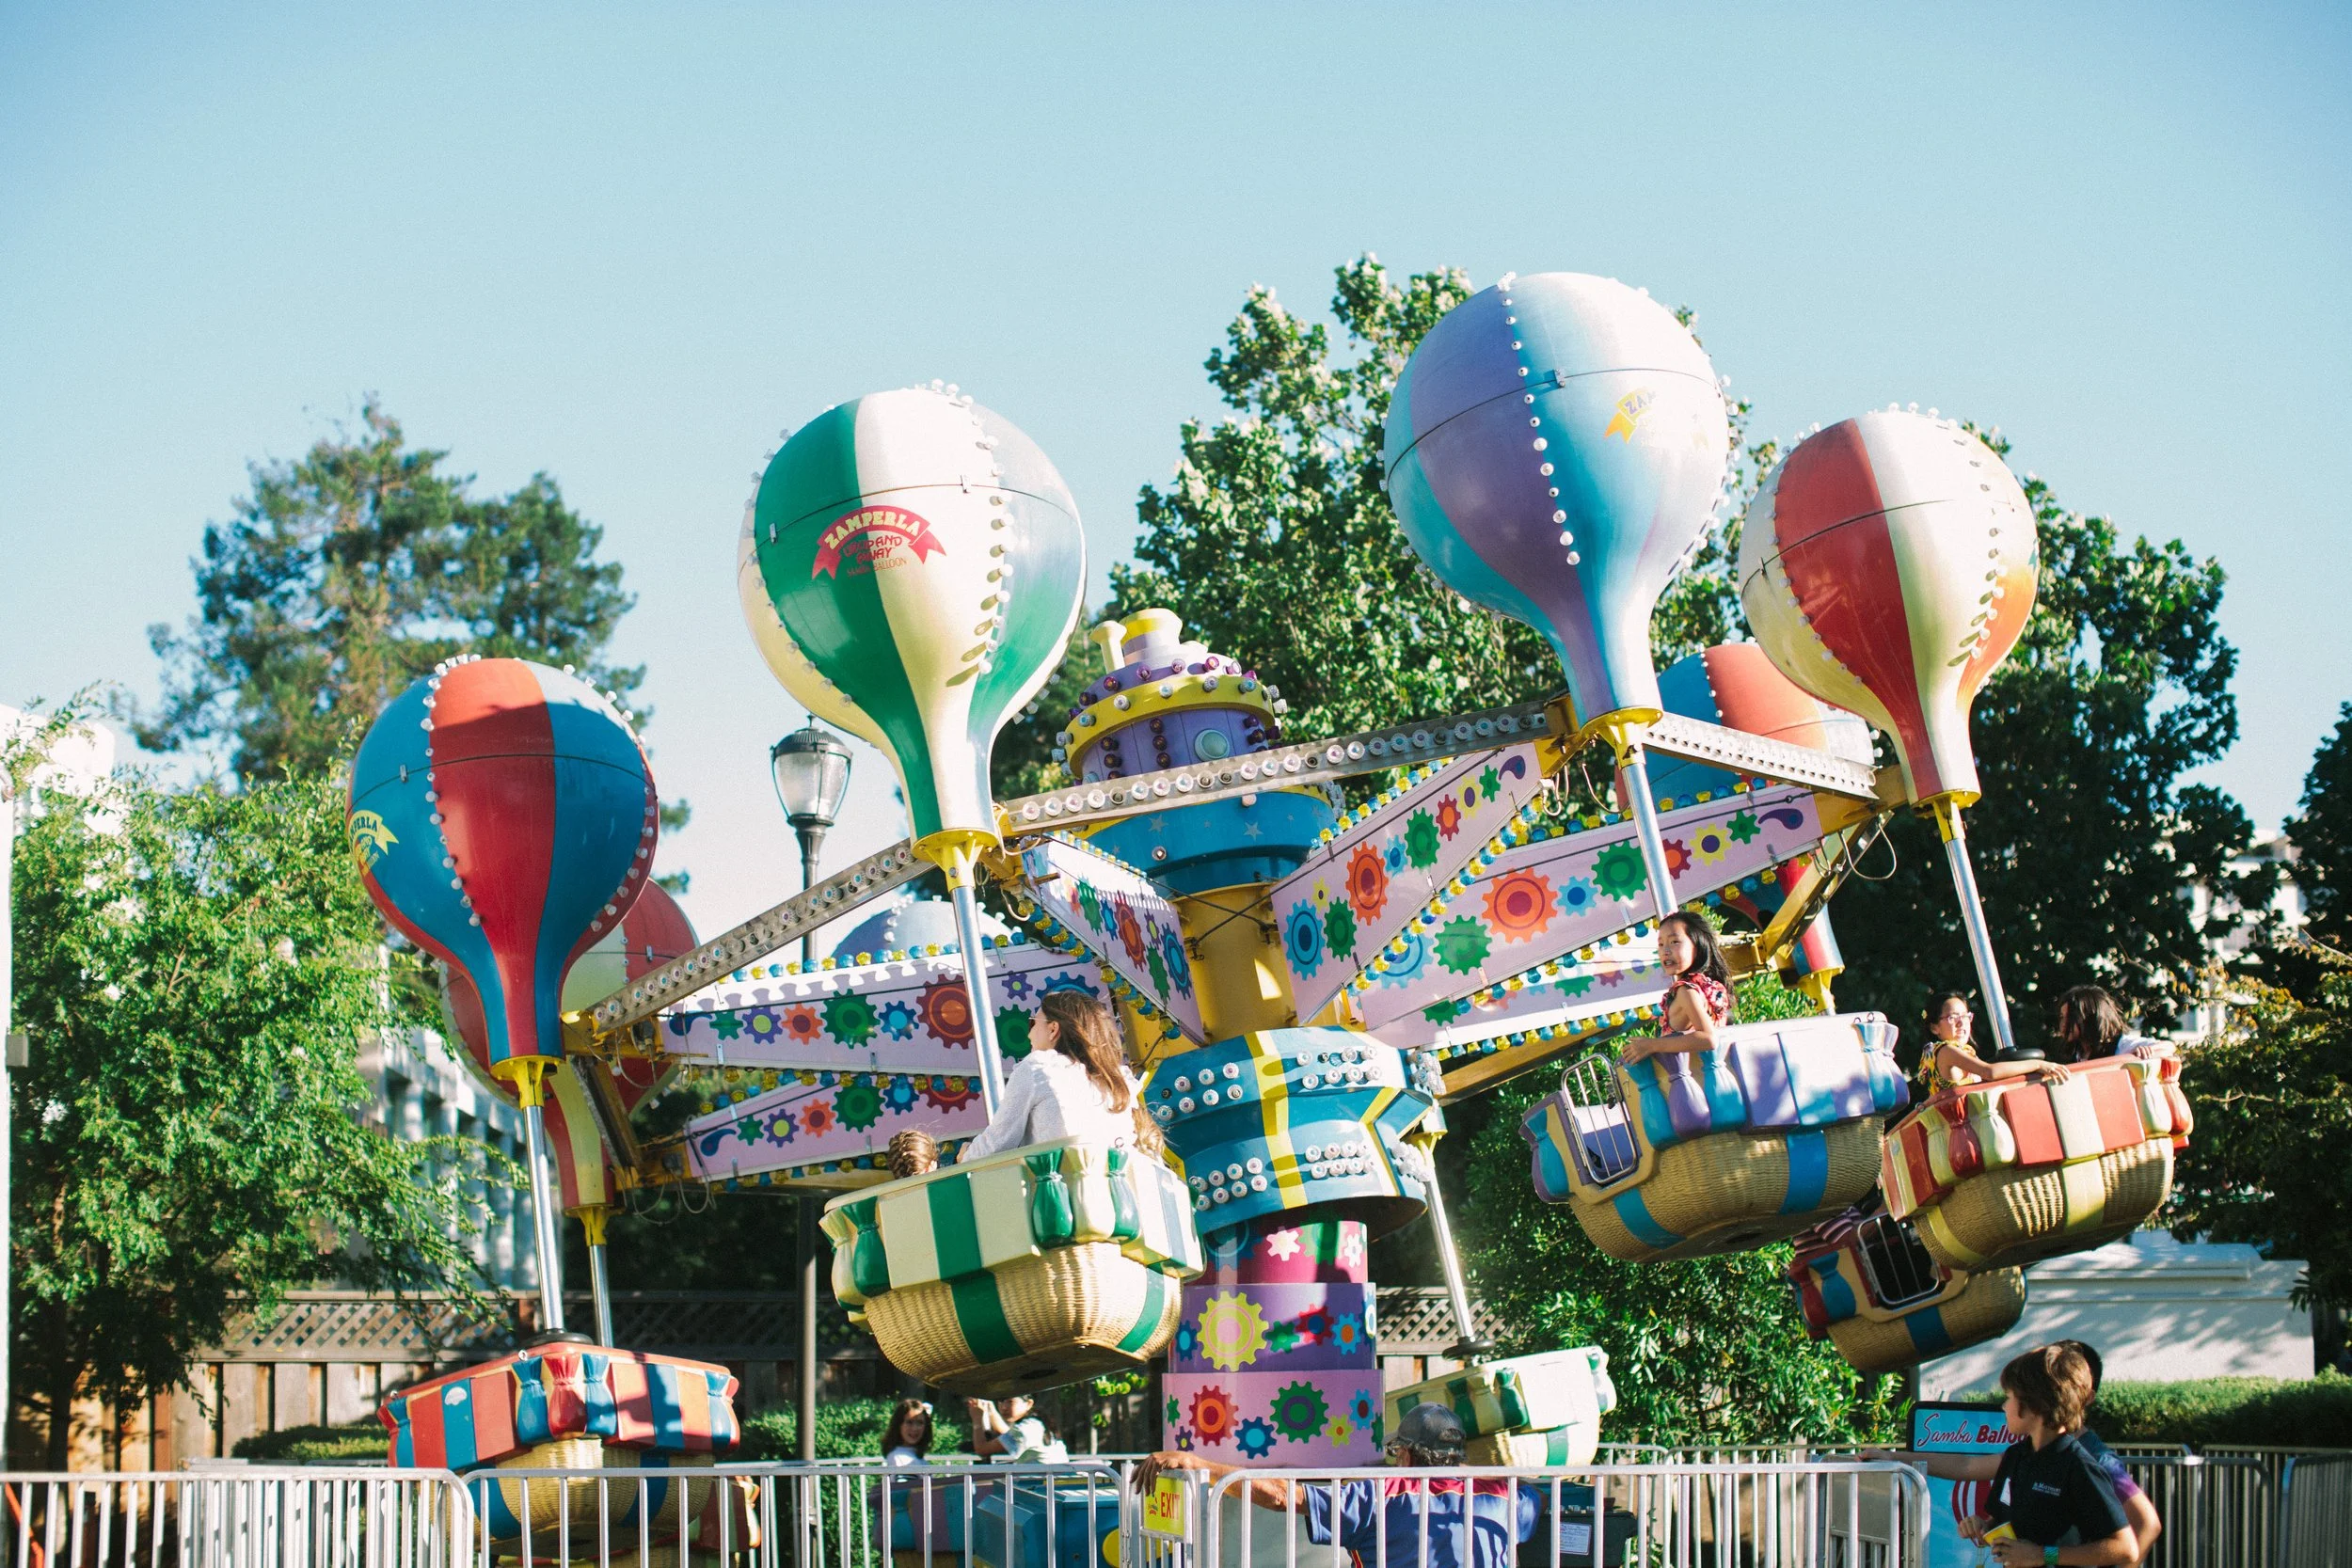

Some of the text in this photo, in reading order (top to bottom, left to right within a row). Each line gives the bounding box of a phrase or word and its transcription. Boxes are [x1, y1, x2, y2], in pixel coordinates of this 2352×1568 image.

[824, 511, 920, 550] ZAMPERLA
[875, 534, 903, 547] AND
[873, 557, 907, 571] BALLOON
[1917, 1413, 1973, 1447] Samba
[1161, 1492, 1180, 1520] EXIT
